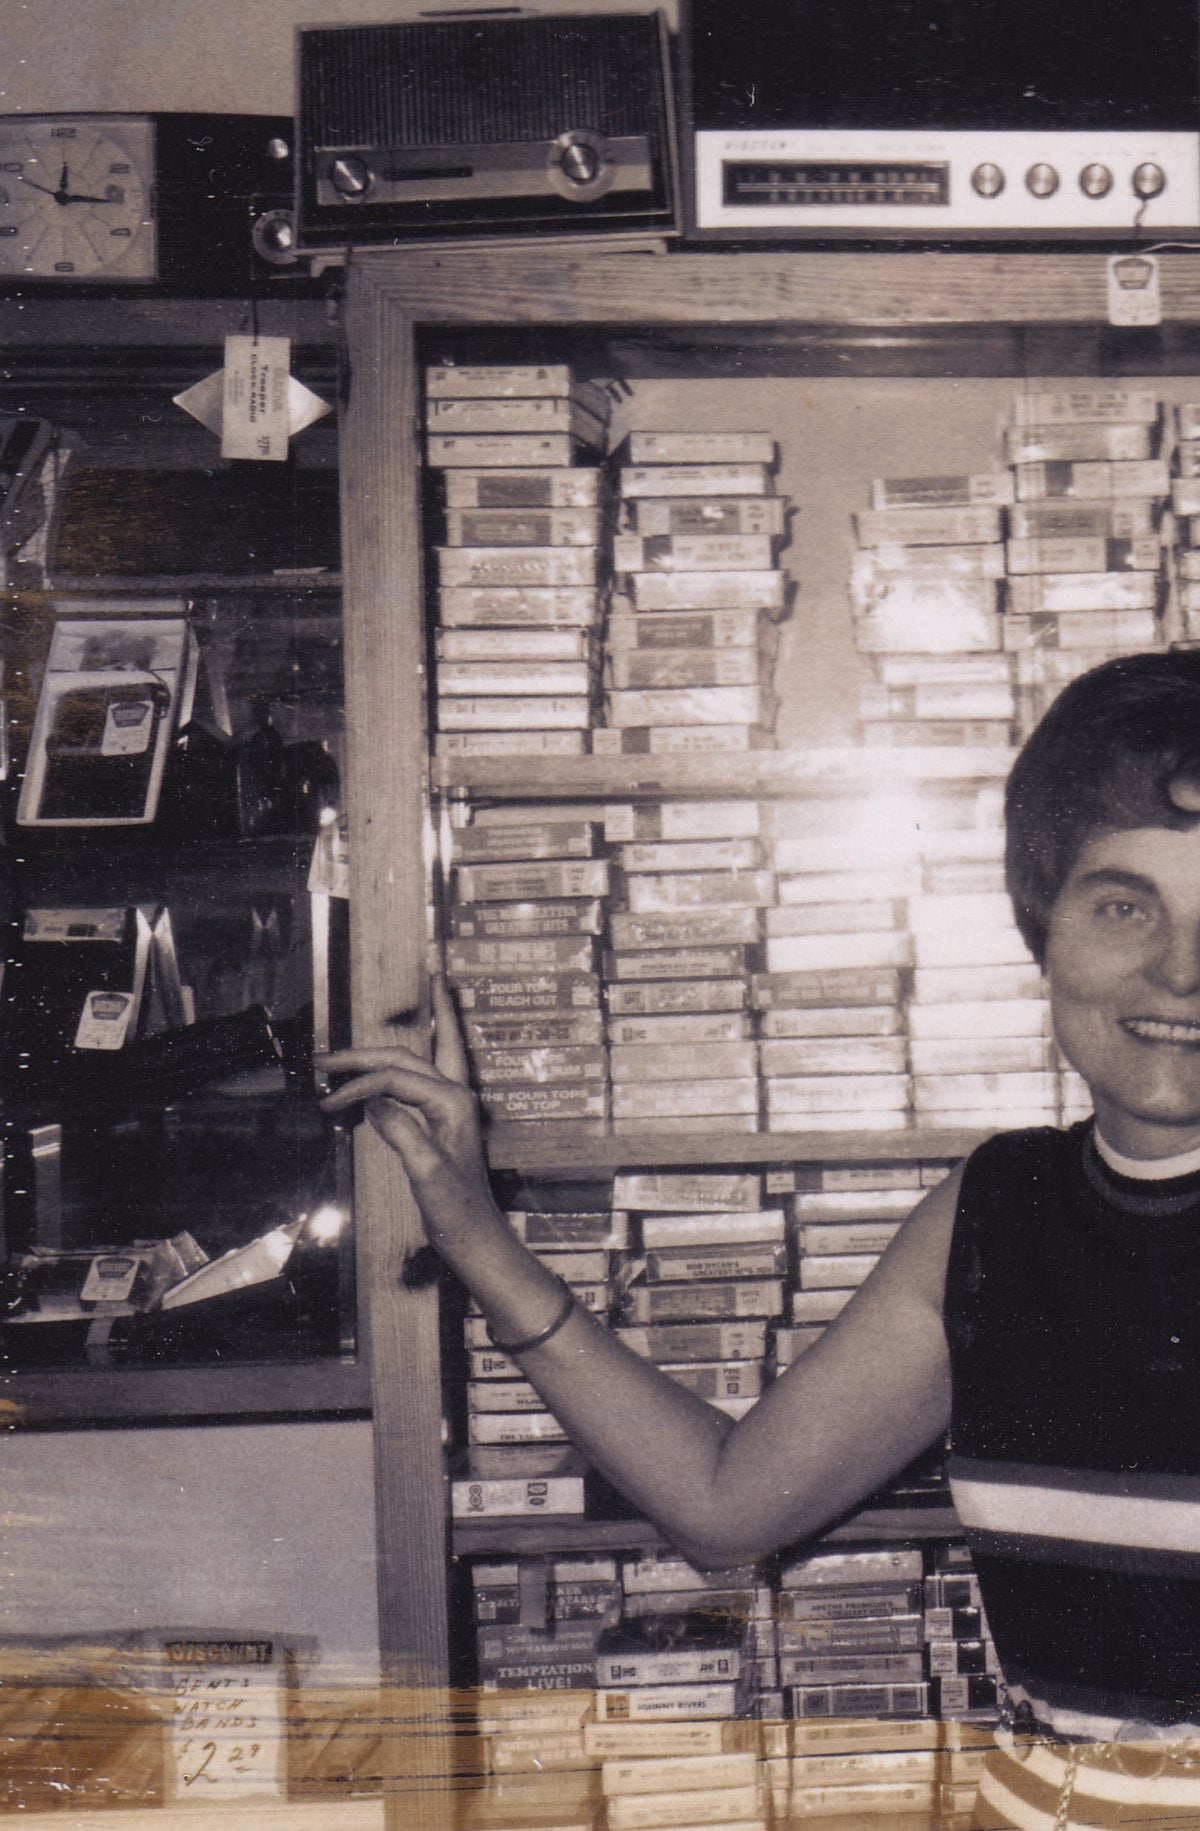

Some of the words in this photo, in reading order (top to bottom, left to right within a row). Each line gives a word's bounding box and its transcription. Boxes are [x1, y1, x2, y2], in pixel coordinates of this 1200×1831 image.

[250, 353, 258, 389] CLOCK
[259, 364, 269, 416] Trooper
[249, 391, 257, 423] RADIO
[489, 996, 530, 1006] REACH
[531, 995, 558, 1005] OUT
[507, 1091, 547, 1101] FOUR
[549, 1089, 588, 1099] TOPS
[506, 1102, 528, 1112] ON
[530, 1100, 562, 1111] TOP
[693, 1267, 733, 1276] GREATEST
[705, 1261, 740, 1269] DYLAN'S
[845, 1601, 894, 1609] FRANKLIN'S
[496, 1663, 596, 1679] TEMPTATION
[175, 1675, 250, 1696] GENTS
[527, 1677, 572, 1690] LIVE!
[174, 1699, 243, 1714] WATCH
[638, 1703, 675, 1711] JOHNNY
[180, 1716, 259, 1731] BANDS
